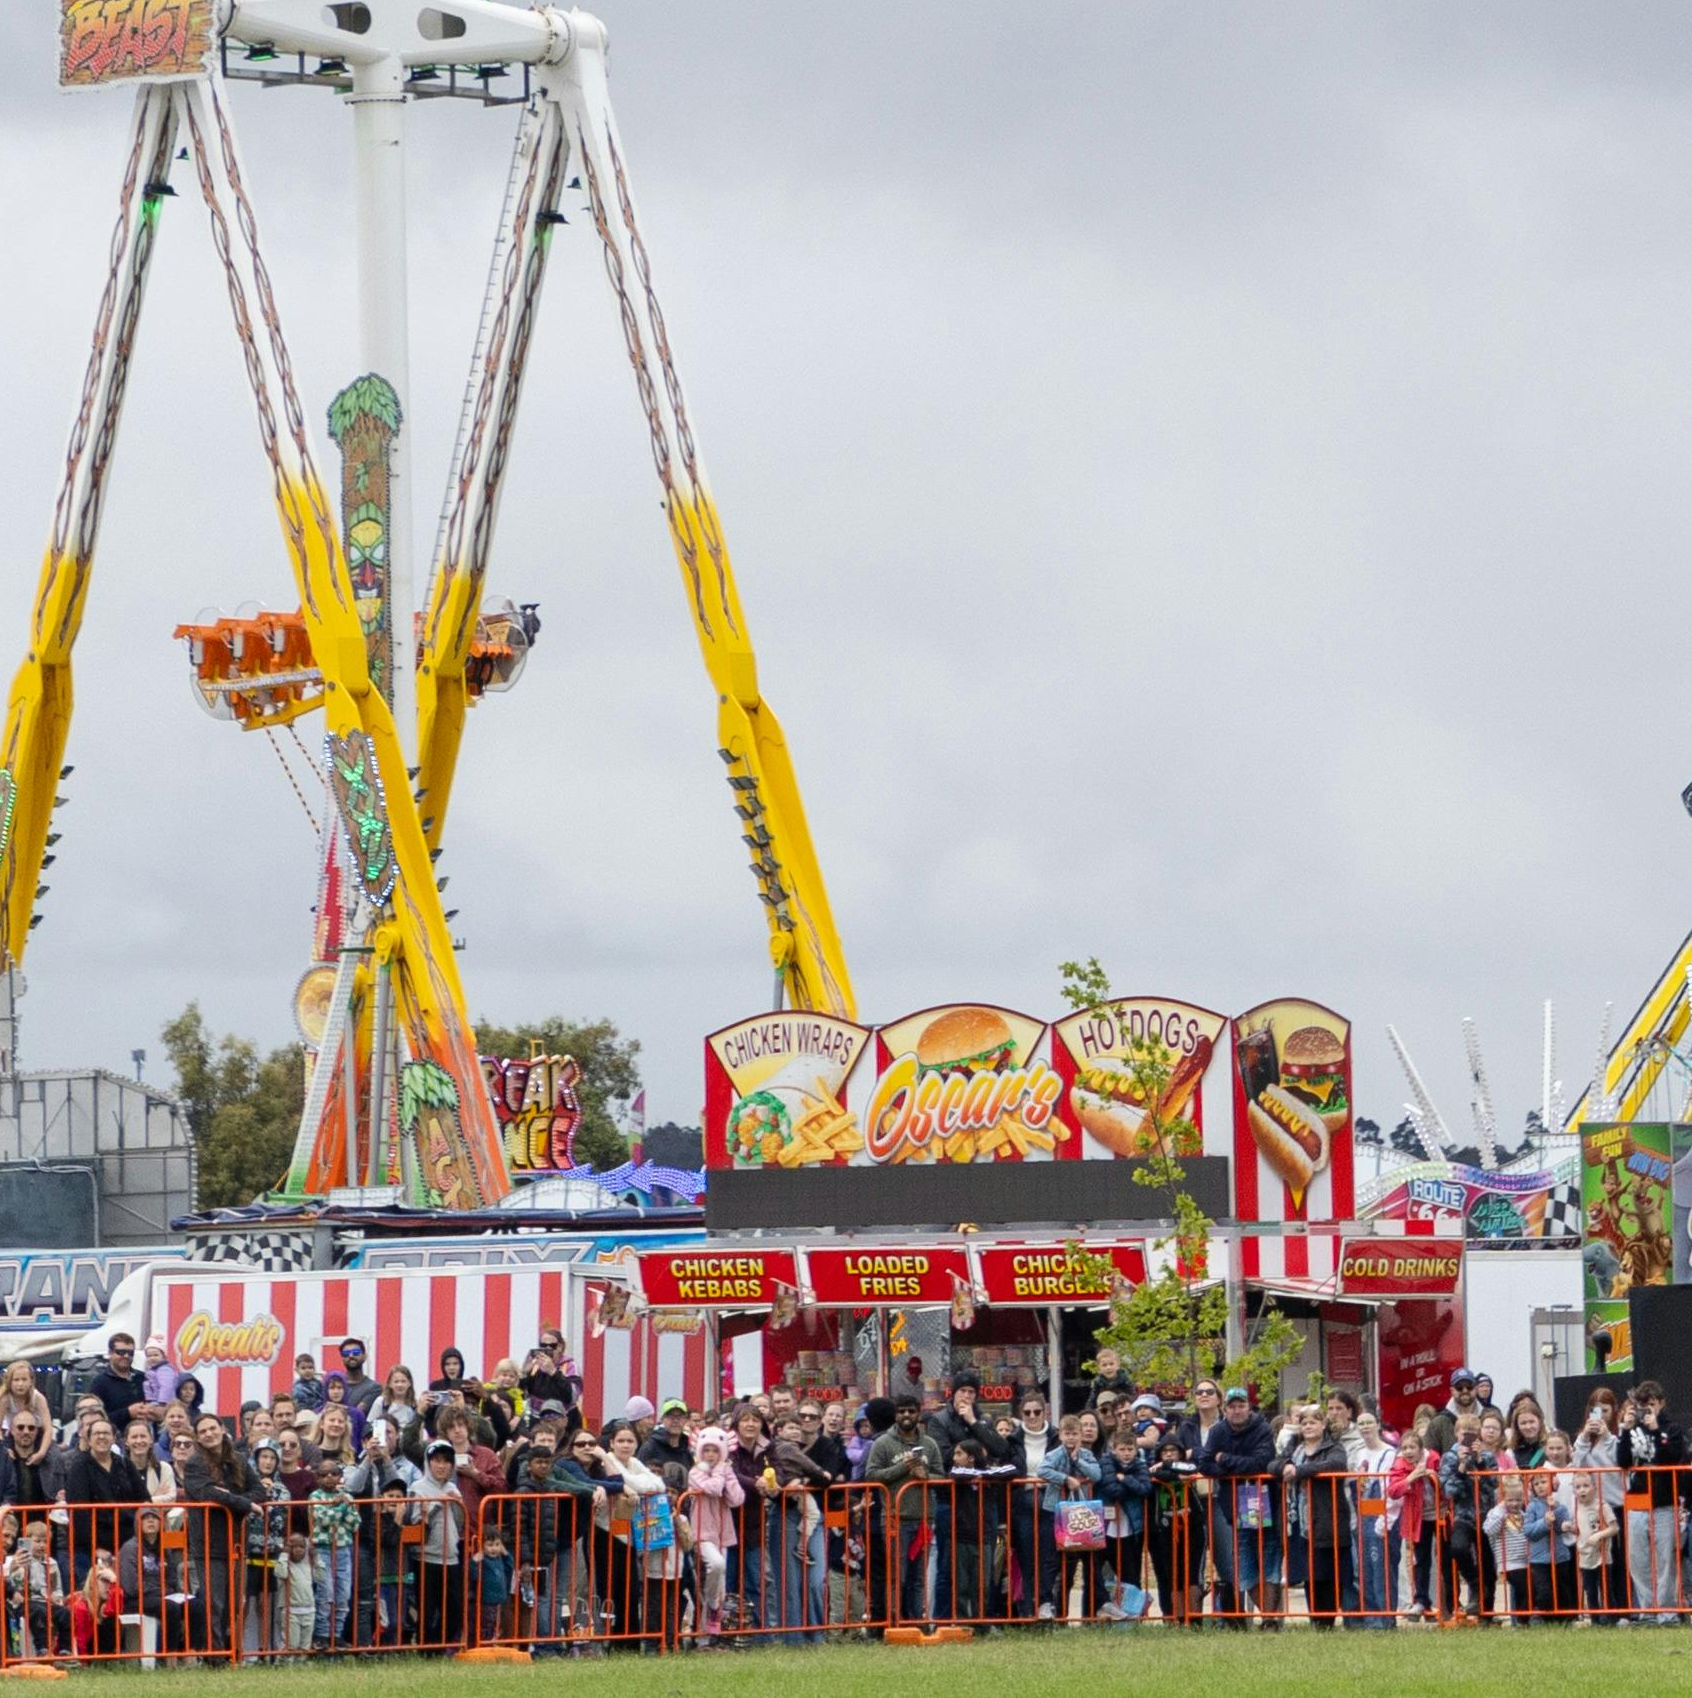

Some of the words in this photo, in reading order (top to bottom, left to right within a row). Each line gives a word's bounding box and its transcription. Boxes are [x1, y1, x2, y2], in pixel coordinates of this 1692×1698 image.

[724, 1023, 791, 1069] CHICKEN
[797, 1022, 855, 1066] WRAPS
[866, 1053, 1064, 1164] Oscar's
[1413, 1180, 1462, 1206] ROUTE
[670, 1258, 764, 1278] CHICKEN
[845, 1256, 930, 1276] LOADED
[1342, 1259, 1389, 1278] COLD
[1394, 1257, 1459, 1278] DRINKS
[678, 1279, 763, 1299] KEBABS
[860, 1276, 921, 1297] FRIES
